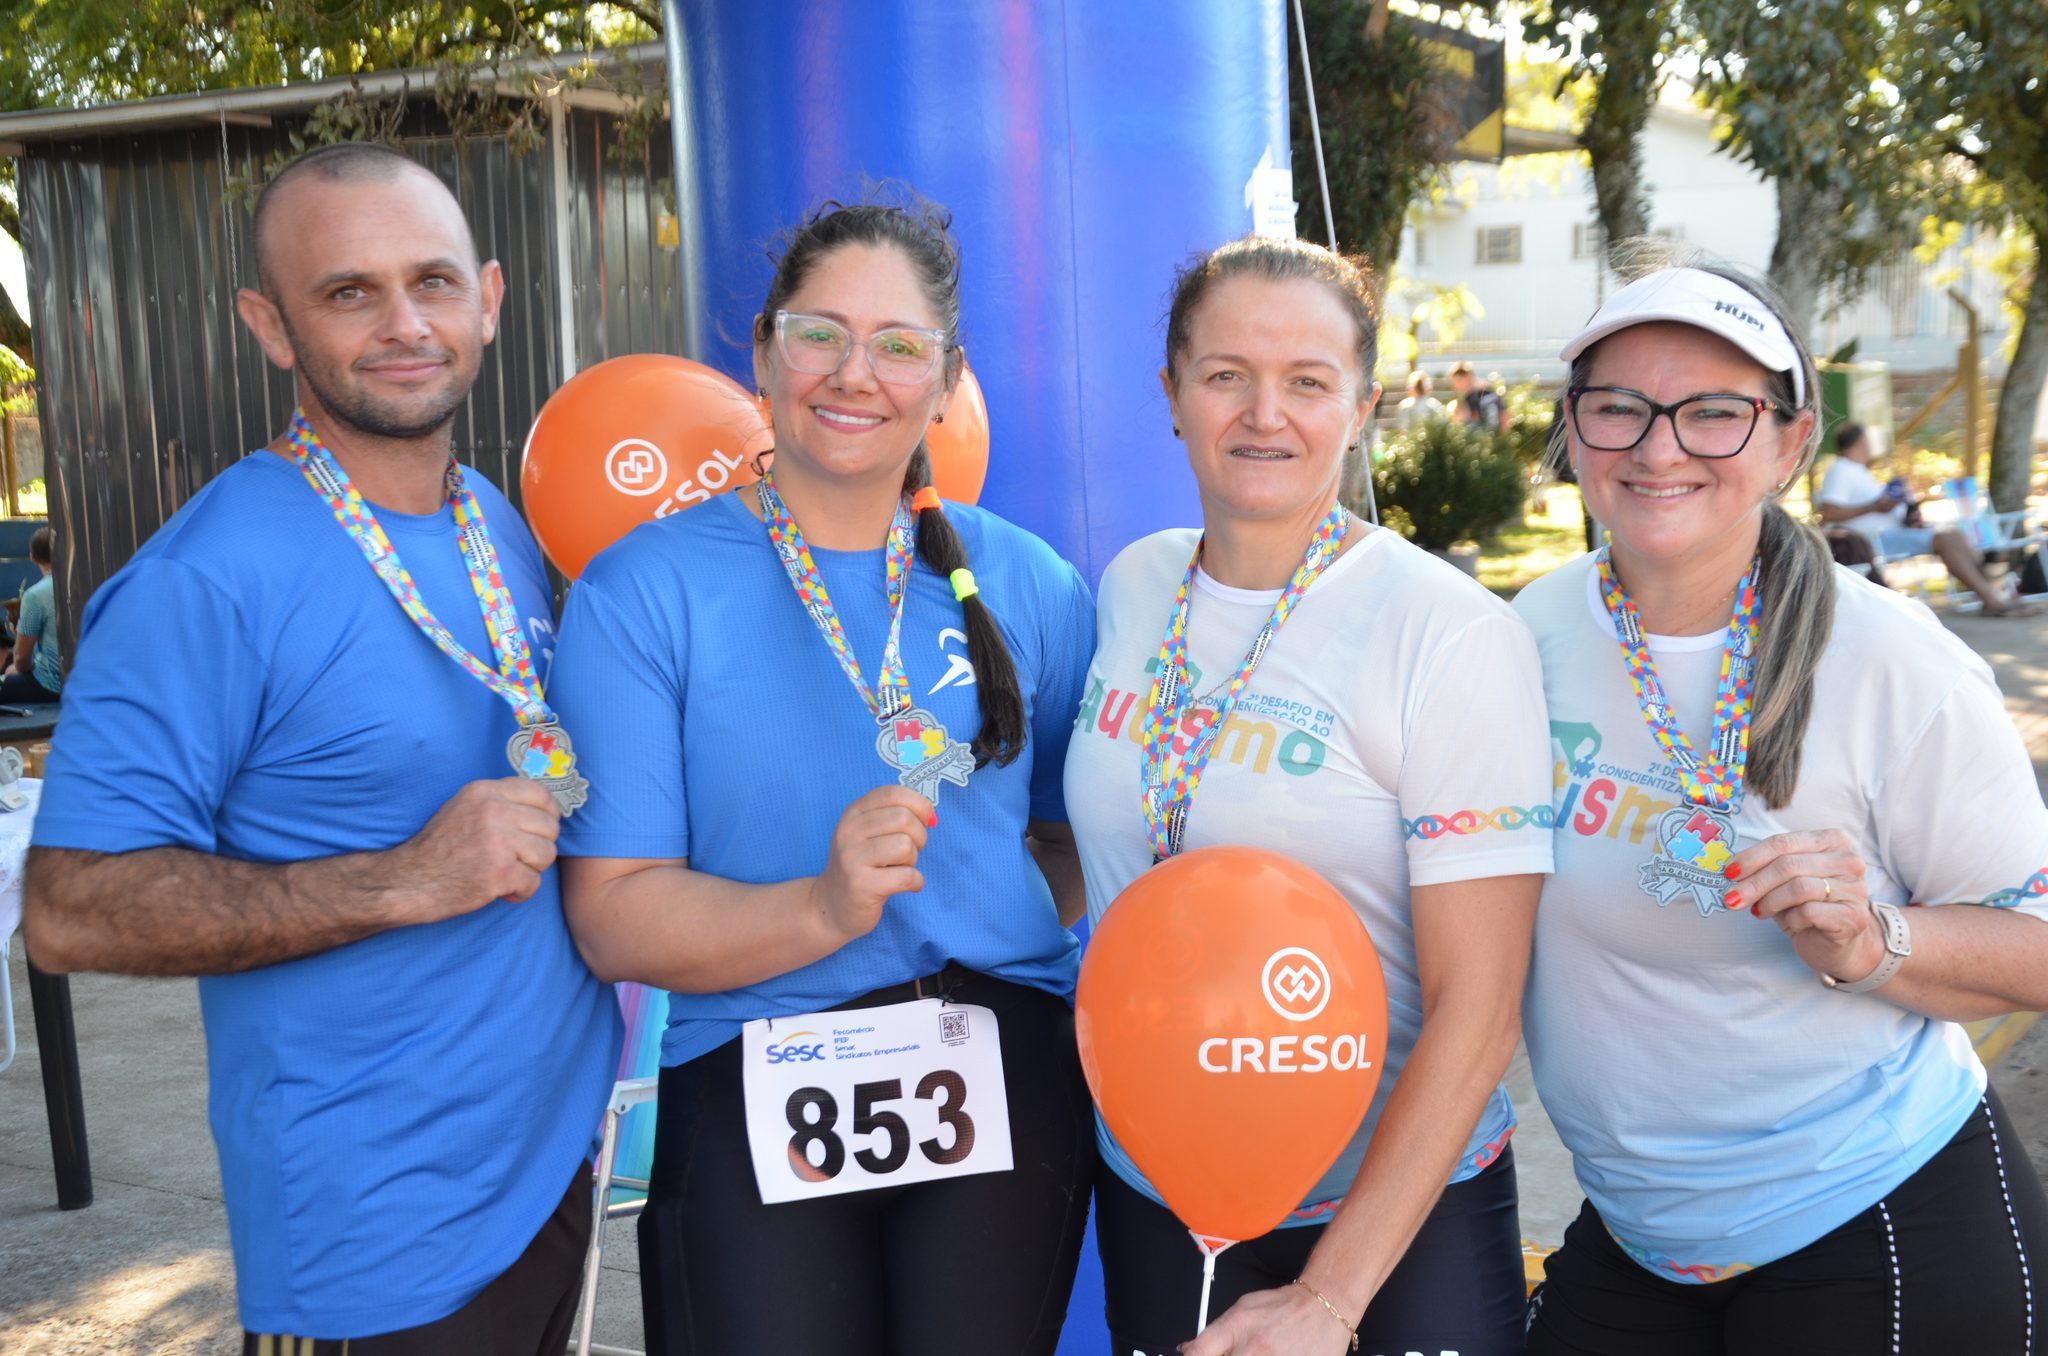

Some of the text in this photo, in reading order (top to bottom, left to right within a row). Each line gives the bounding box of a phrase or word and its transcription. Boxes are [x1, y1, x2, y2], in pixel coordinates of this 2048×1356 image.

[1714, 300, 1764, 331] HUPI
[1158, 673, 1166, 698] DESAFIO
[1163, 663, 1168, 672] EM
[1260, 695, 1312, 716] DESAFIO
[1315, 710, 1335, 726] EM
[1309, 723, 1331, 737] AO
[836, 1044, 921, 1060] Sindicatos Empresariais
[1198, 1034, 1372, 1073] CRESOL
[785, 1069, 976, 1183] 853
